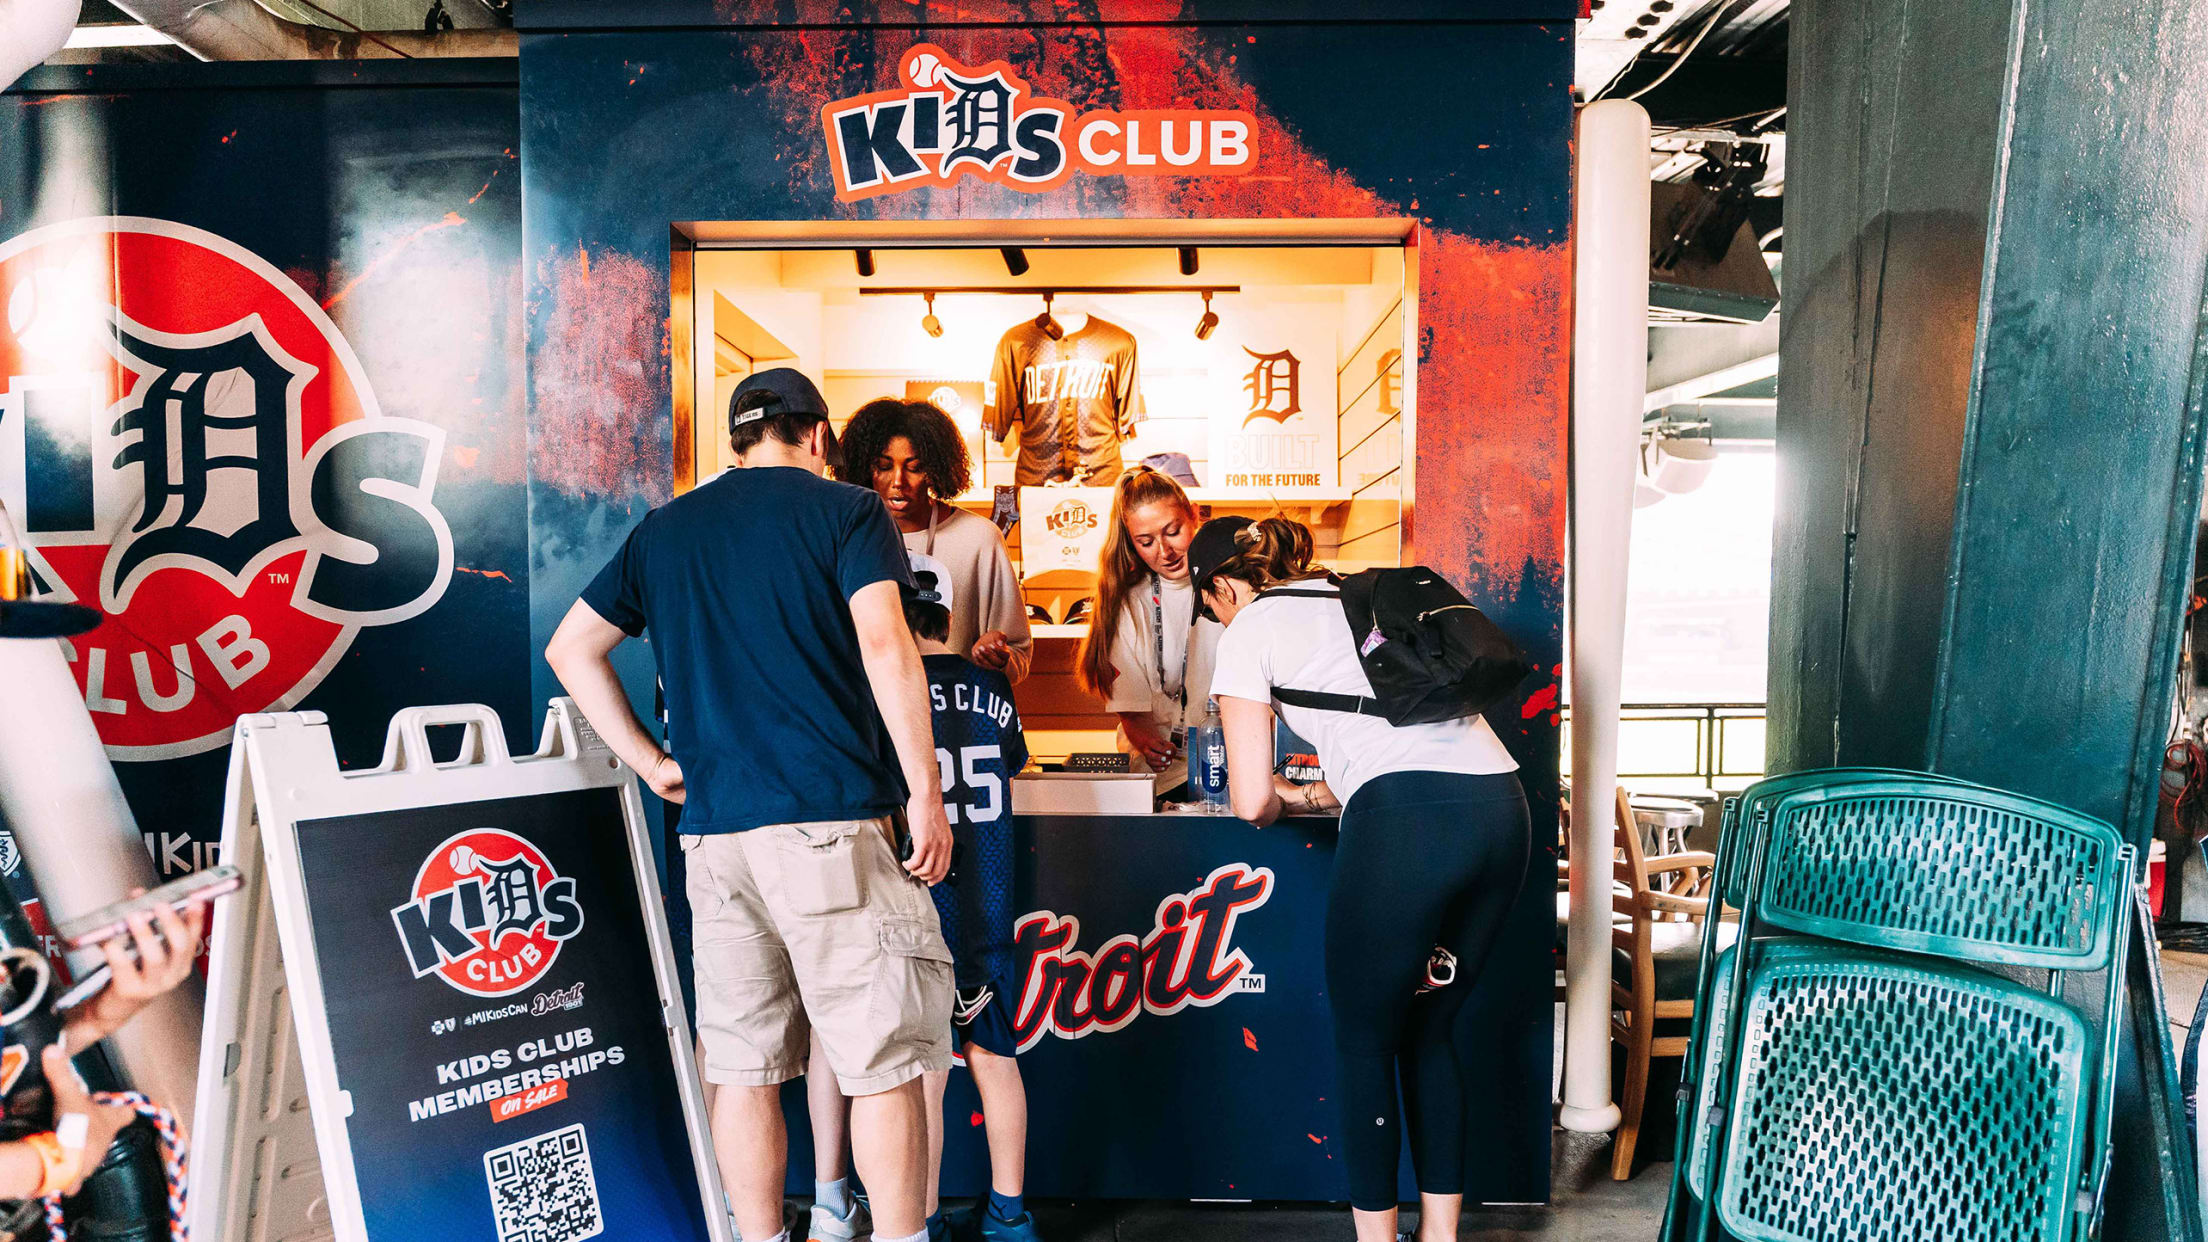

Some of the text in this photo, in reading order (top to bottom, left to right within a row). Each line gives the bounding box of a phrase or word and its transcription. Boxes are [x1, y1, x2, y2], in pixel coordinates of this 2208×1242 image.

[835, 70, 1248, 189] KIDS CLUB
[1025, 359, 1115, 404] DETROIT
[0, 316, 450, 616] IDS
[1225, 433, 1320, 470] BUILT
[1226, 474, 1320, 486] FOR THE FUTURE
[1046, 506, 1098, 531] KIDS
[268, 573, 289, 584] TM
[59, 614, 271, 715] LUB
[930, 683, 1013, 728] S CLUB
[1207, 745, 1220, 787] smart
[394, 854, 582, 975] KIDS
[467, 943, 542, 983] CLUB
[1014, 864, 1272, 1054] troit
[1240, 977, 1261, 989] TM
[436, 1027, 594, 1084] KIDS CLUB
[408, 1046, 625, 1122] MEMBERSHIPS
[525, 1085, 558, 1109] SALE
